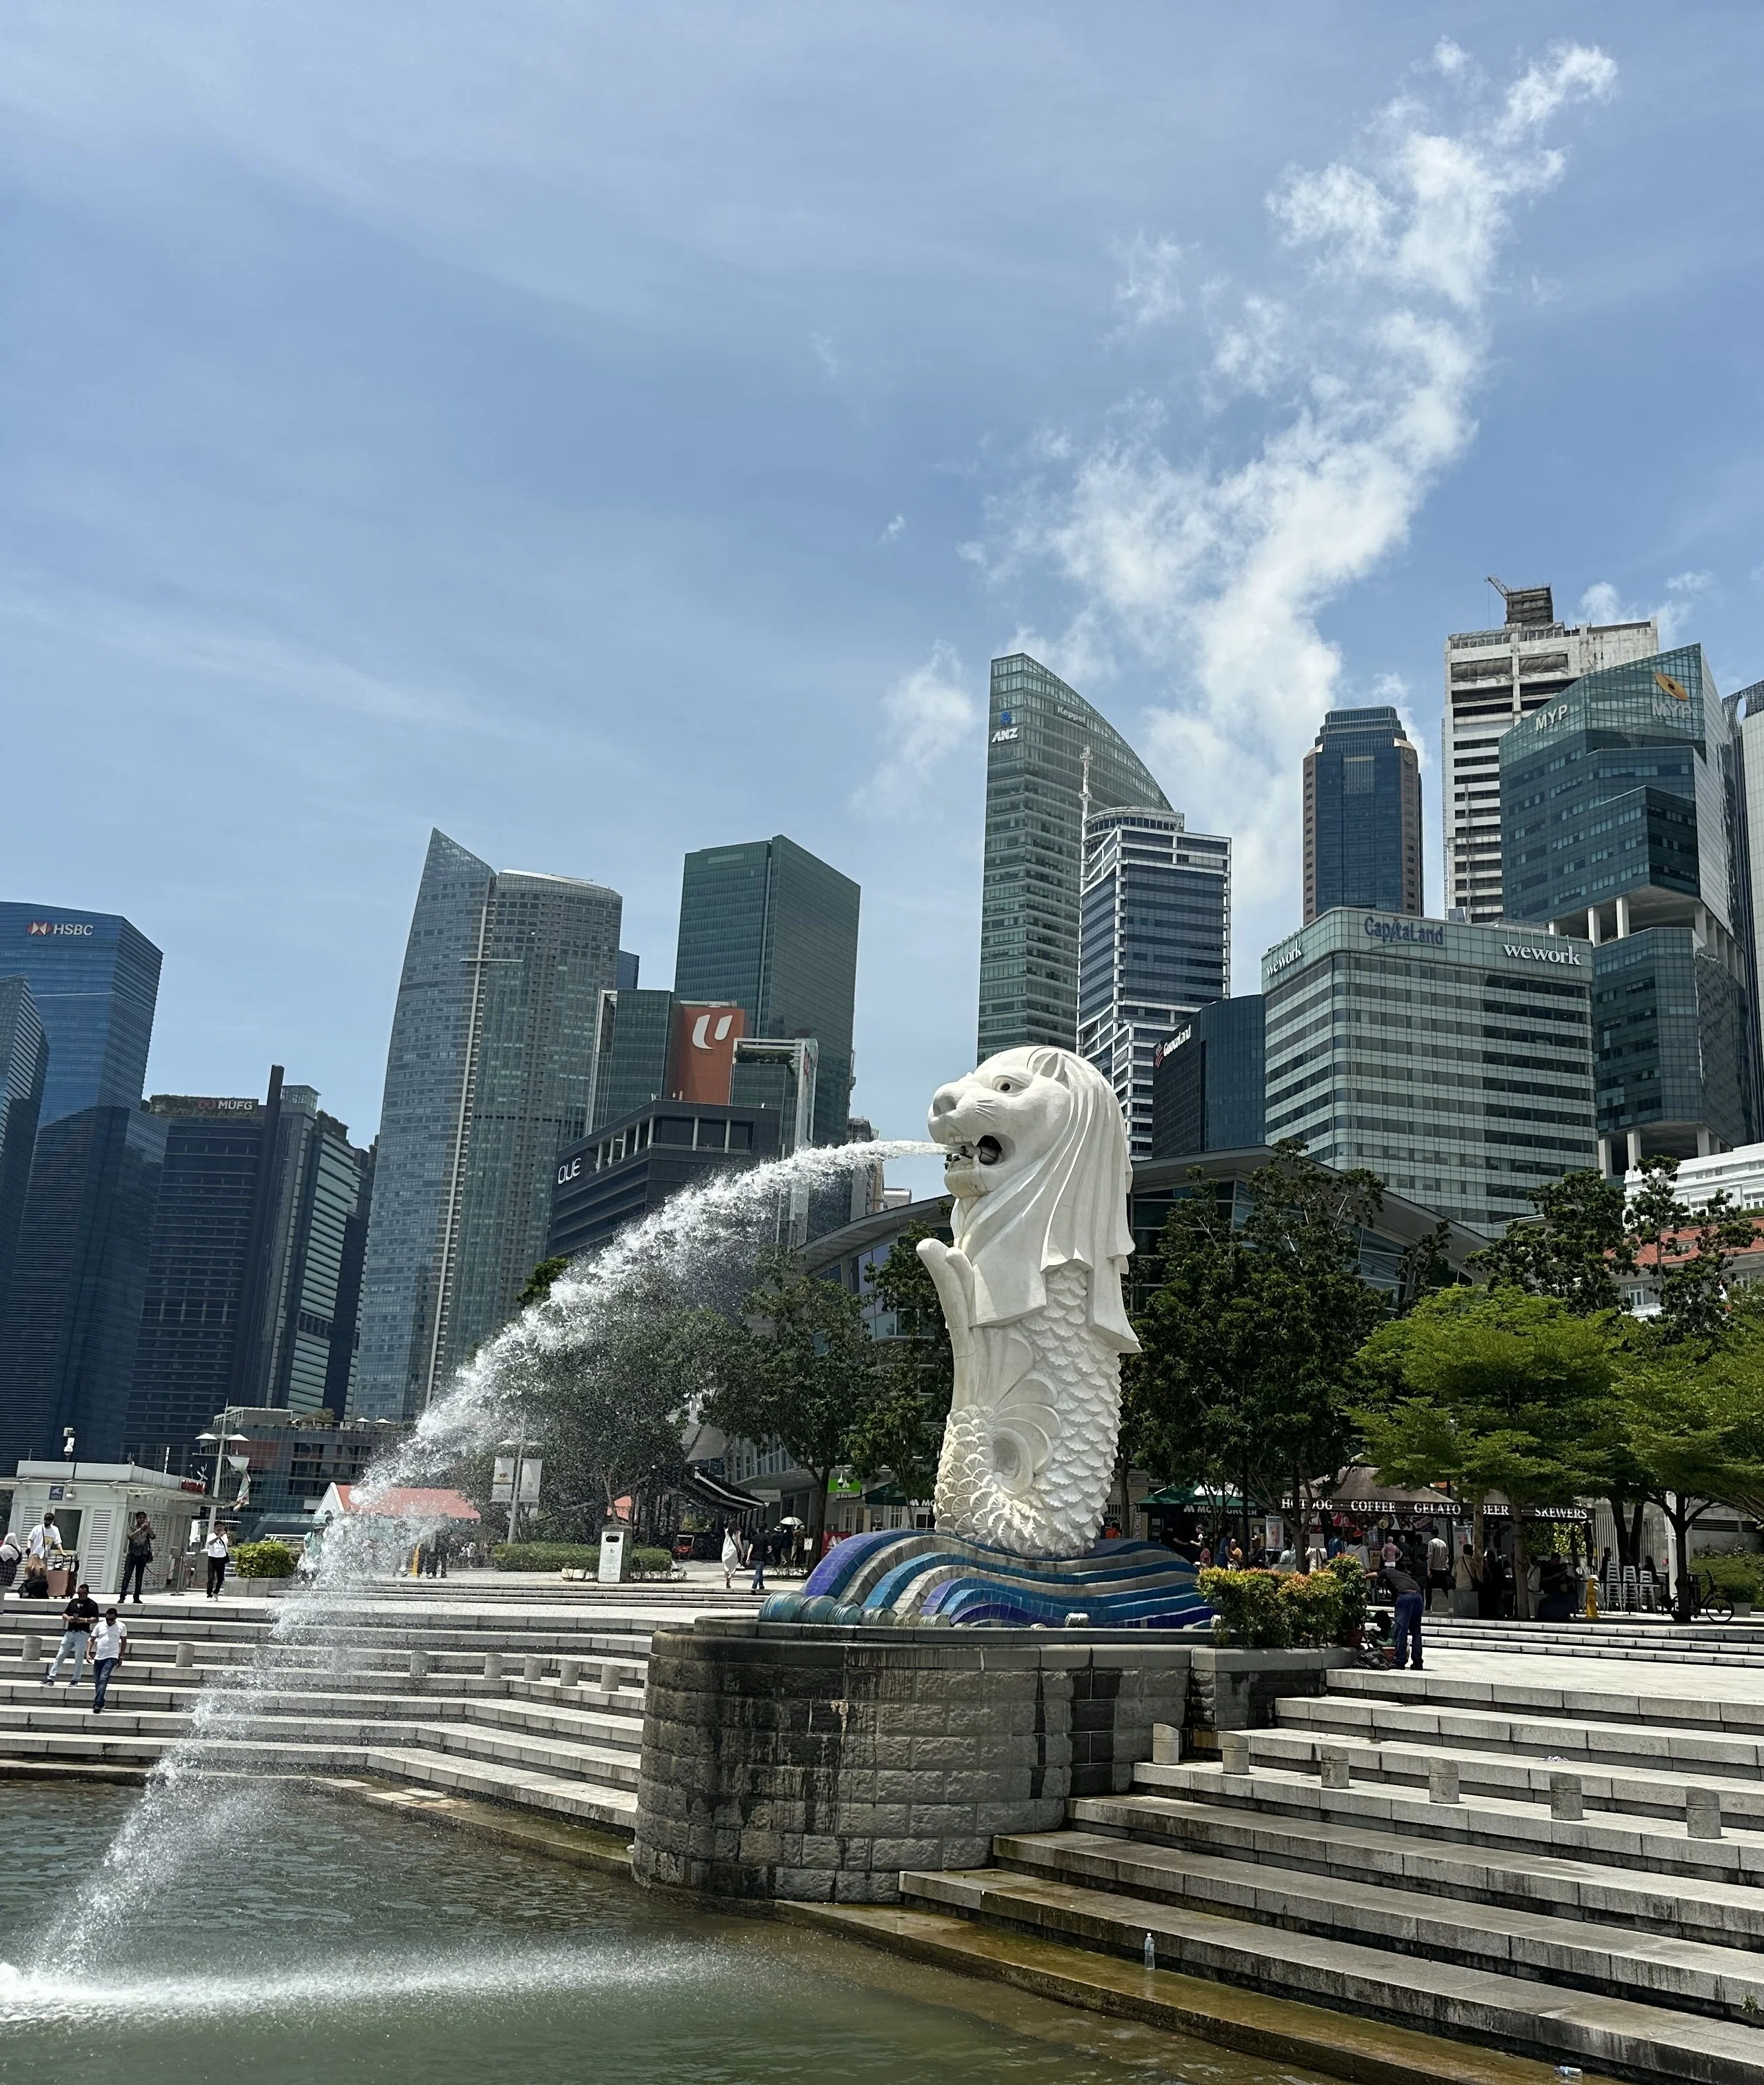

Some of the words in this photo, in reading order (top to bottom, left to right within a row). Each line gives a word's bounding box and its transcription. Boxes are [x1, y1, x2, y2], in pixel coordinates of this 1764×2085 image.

[1057, 705, 1086, 724] Keppel
[1535, 704, 1568, 732] MYP
[1652, 701, 1693, 719] MYP
[991, 727, 1019, 743] ANZ
[52, 924, 94, 936] HSBC
[1365, 916, 1443, 945] CapitaLand
[1266, 938, 1303, 976] wework
[1503, 945, 1582, 965] wework
[217, 1100, 253, 1110] MUFG
[1281, 1498, 1307, 1510] HT
[1350, 1500, 1396, 1513] COFFEE
[1414, 1502, 1461, 1515] GELATO
[1534, 1507, 1588, 1519] SKEWERS
